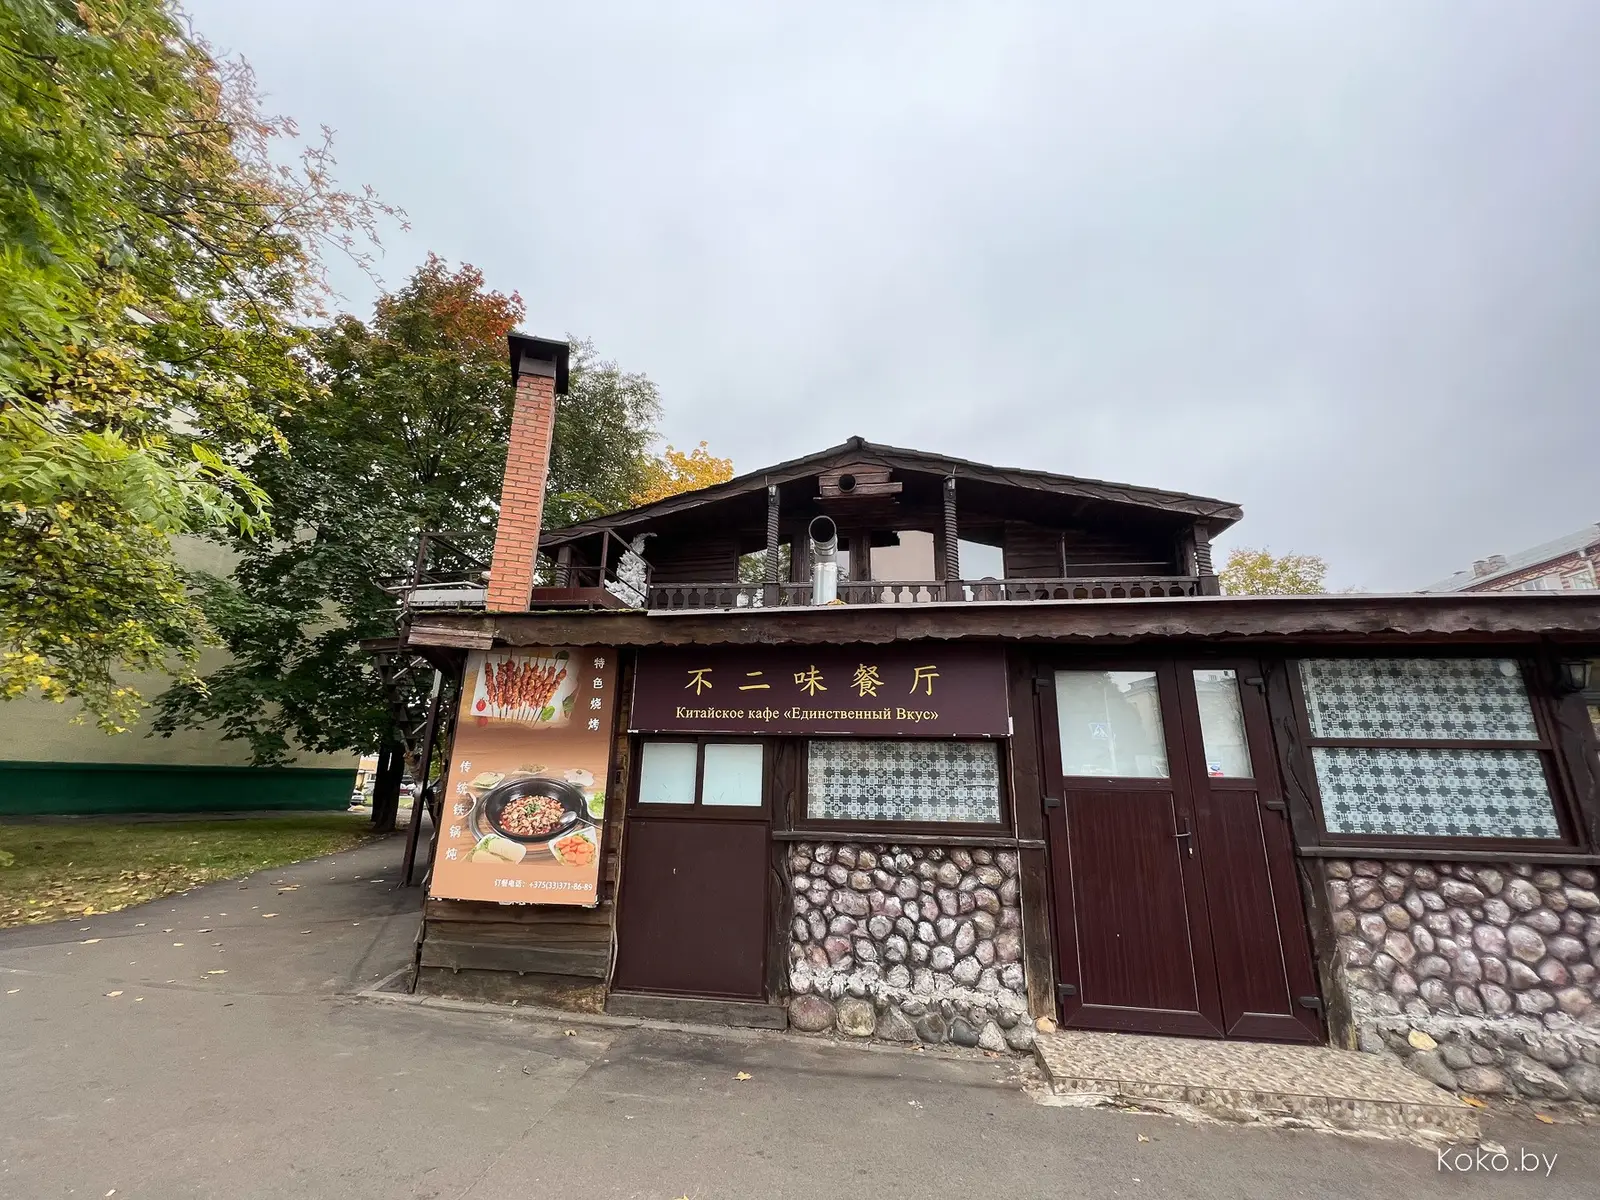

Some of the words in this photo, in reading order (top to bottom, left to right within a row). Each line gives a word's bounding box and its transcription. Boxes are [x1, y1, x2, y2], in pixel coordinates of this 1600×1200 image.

[588, 657, 605, 731] 特色烧烤
[685, 663, 940, 698] 不二味餐厅
[675, 706, 745, 719] Китайское
[748, 708, 780, 722] кафе
[784, 707, 892, 721] «Единственный
[896, 708, 939, 723] Вкус»
[445, 760, 472, 861] 传统铁锅炖
[529, 881, 593, 891] +375(33)371-86-89
